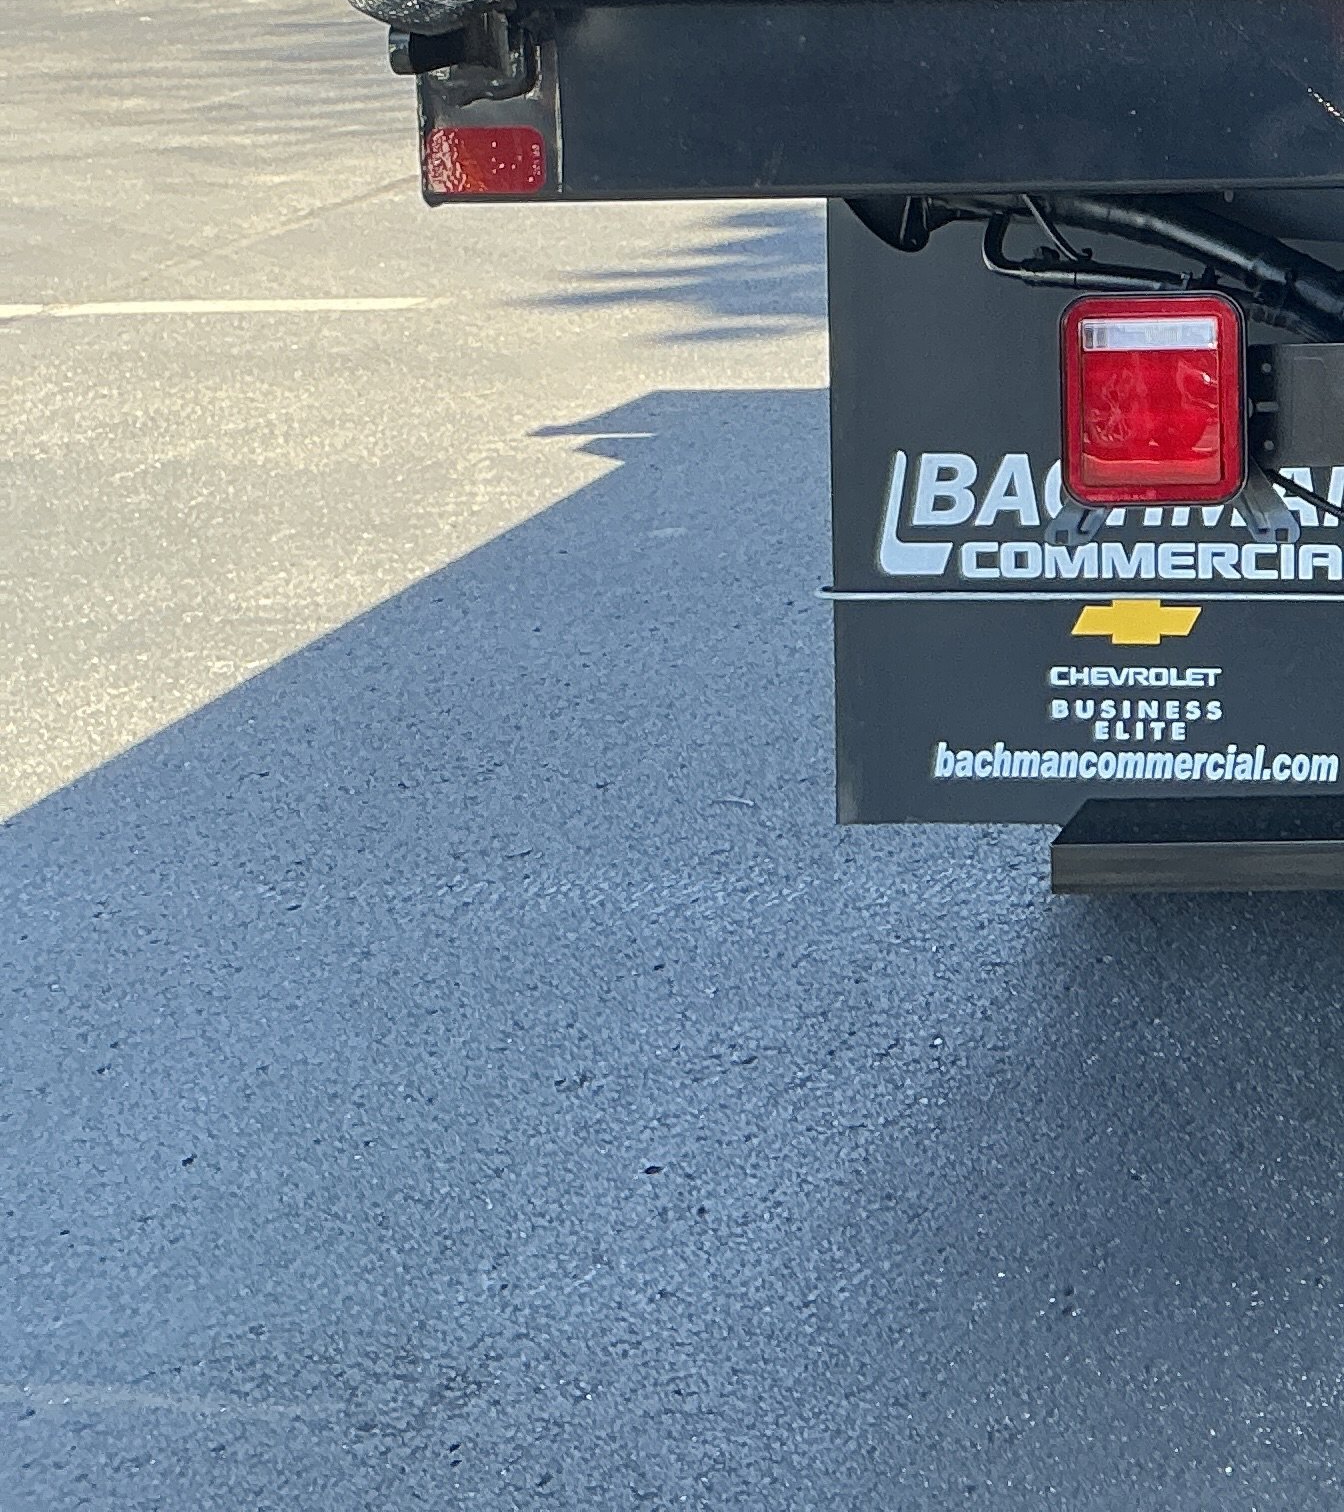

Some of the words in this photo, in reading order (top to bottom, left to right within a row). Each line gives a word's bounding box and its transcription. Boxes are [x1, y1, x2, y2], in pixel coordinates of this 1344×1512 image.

[1049, 665, 1223, 687] CHEVROLET
[1051, 699, 1224, 720] BUSINESS
[1095, 721, 1187, 741] ELITE
[934, 742, 1339, 782] bachmancommercial.com
